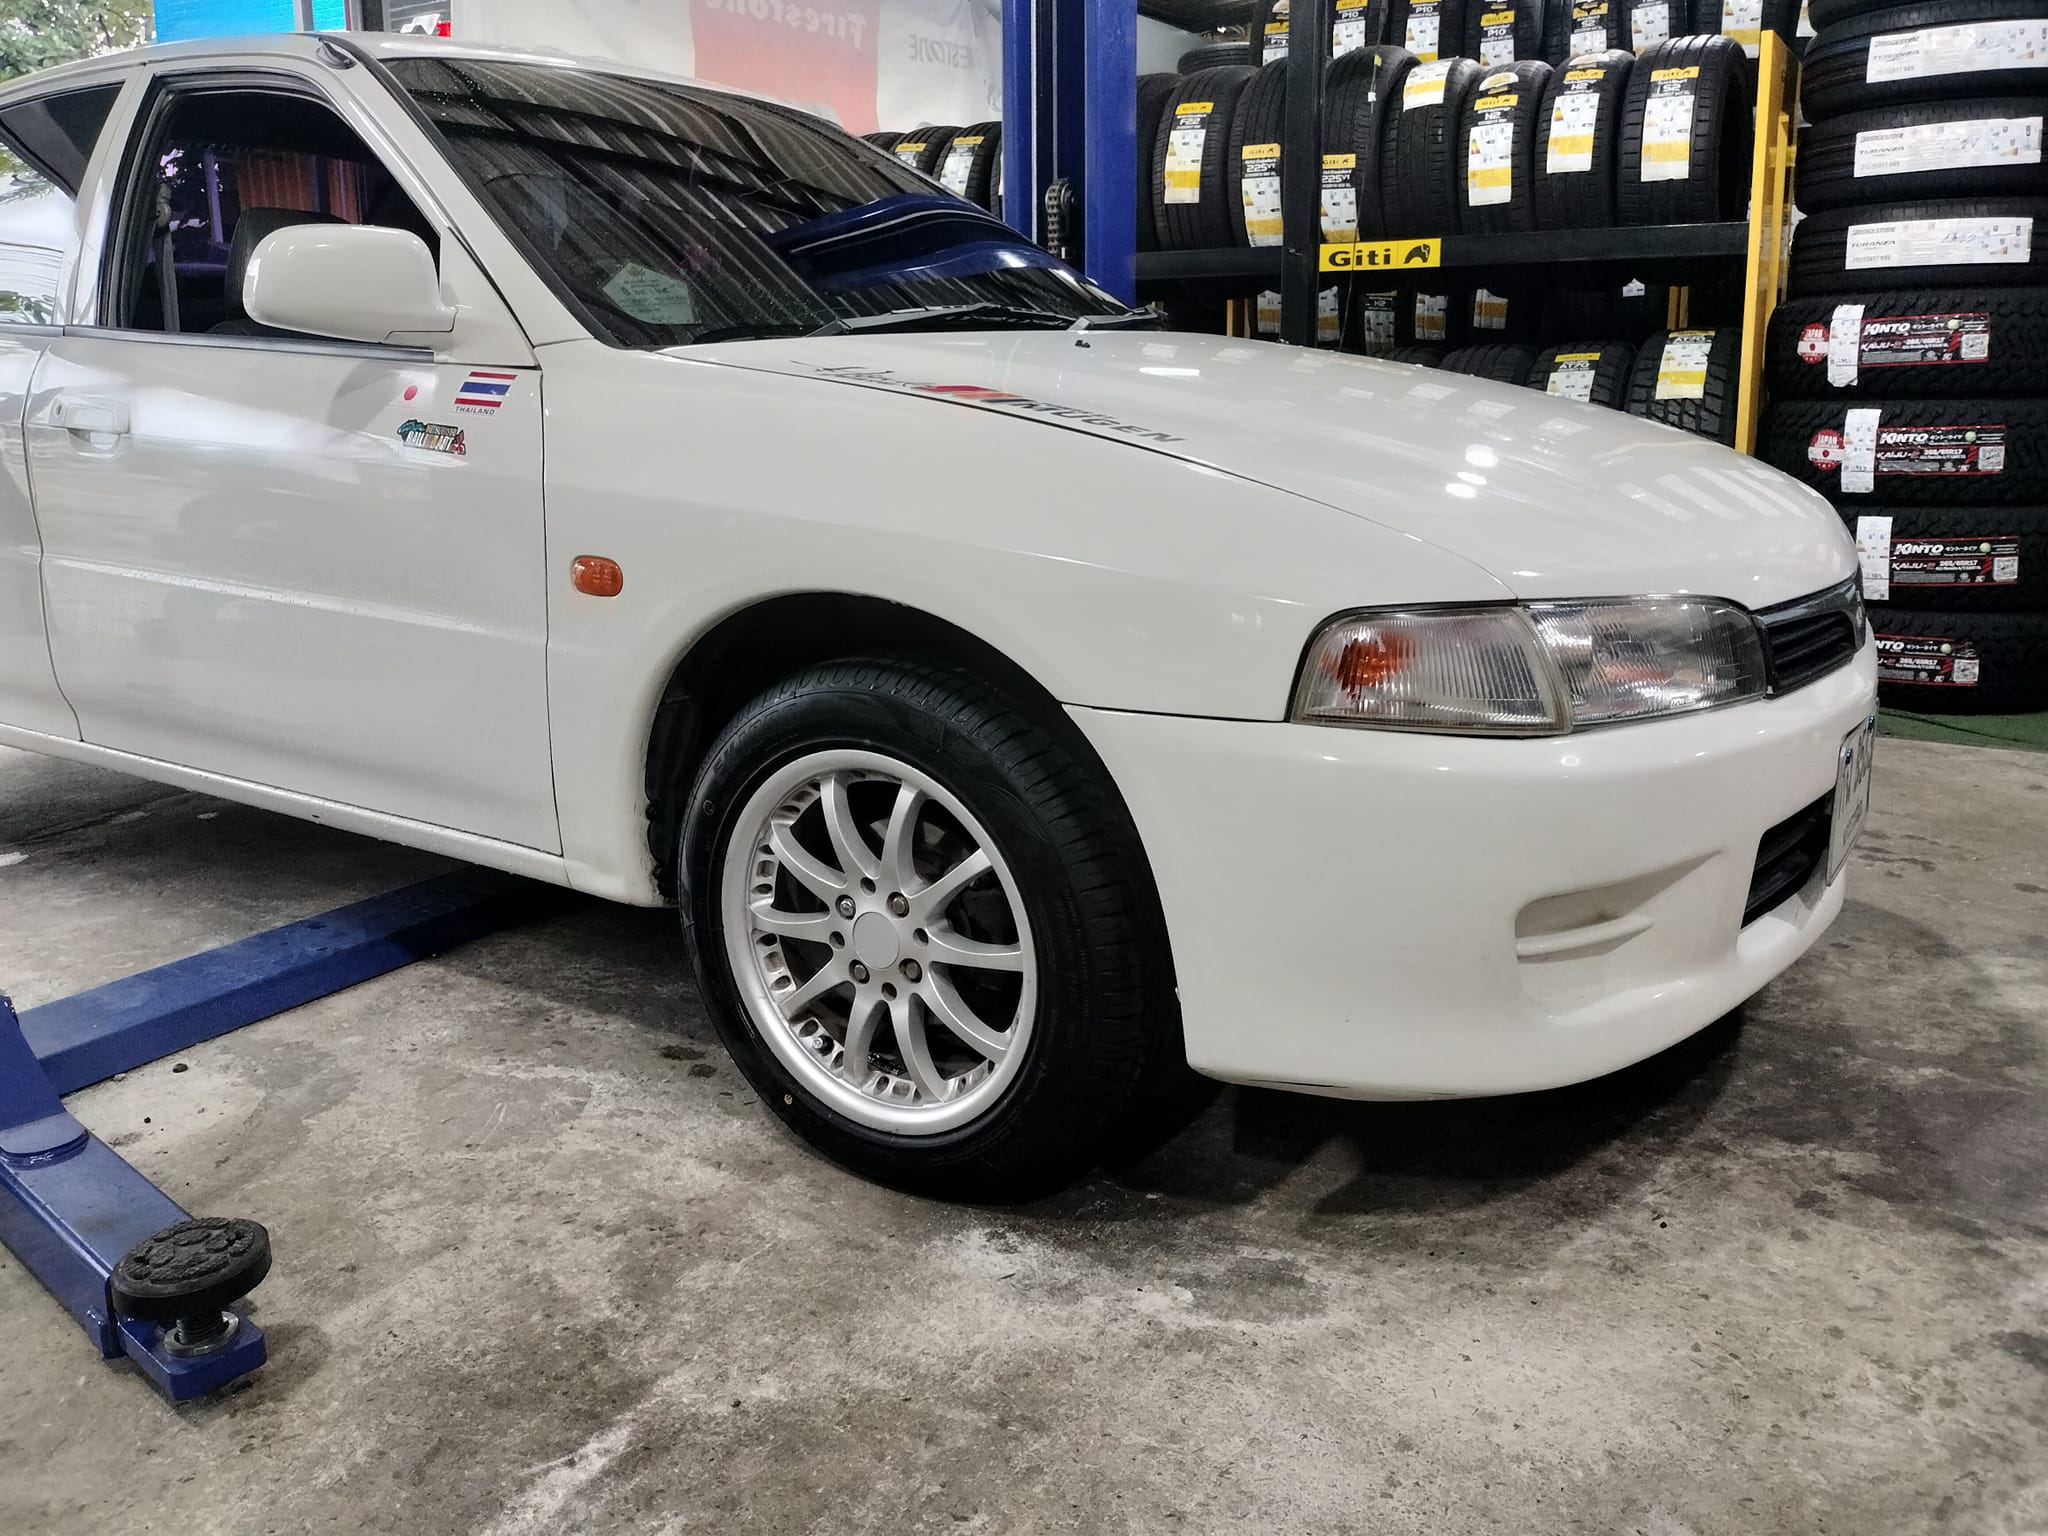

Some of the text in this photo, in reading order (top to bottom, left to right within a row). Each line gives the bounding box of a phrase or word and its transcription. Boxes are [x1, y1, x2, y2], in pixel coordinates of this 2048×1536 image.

[1328, 248, 1392, 267] Giti
[1863, 322, 1911, 337] KINTO
[455, 406, 496, 416] THAILAND
[1880, 432, 1929, 444] KINTO
[1894, 543, 1945, 556] KINTO
[1875, 640, 1905, 650] NTO
